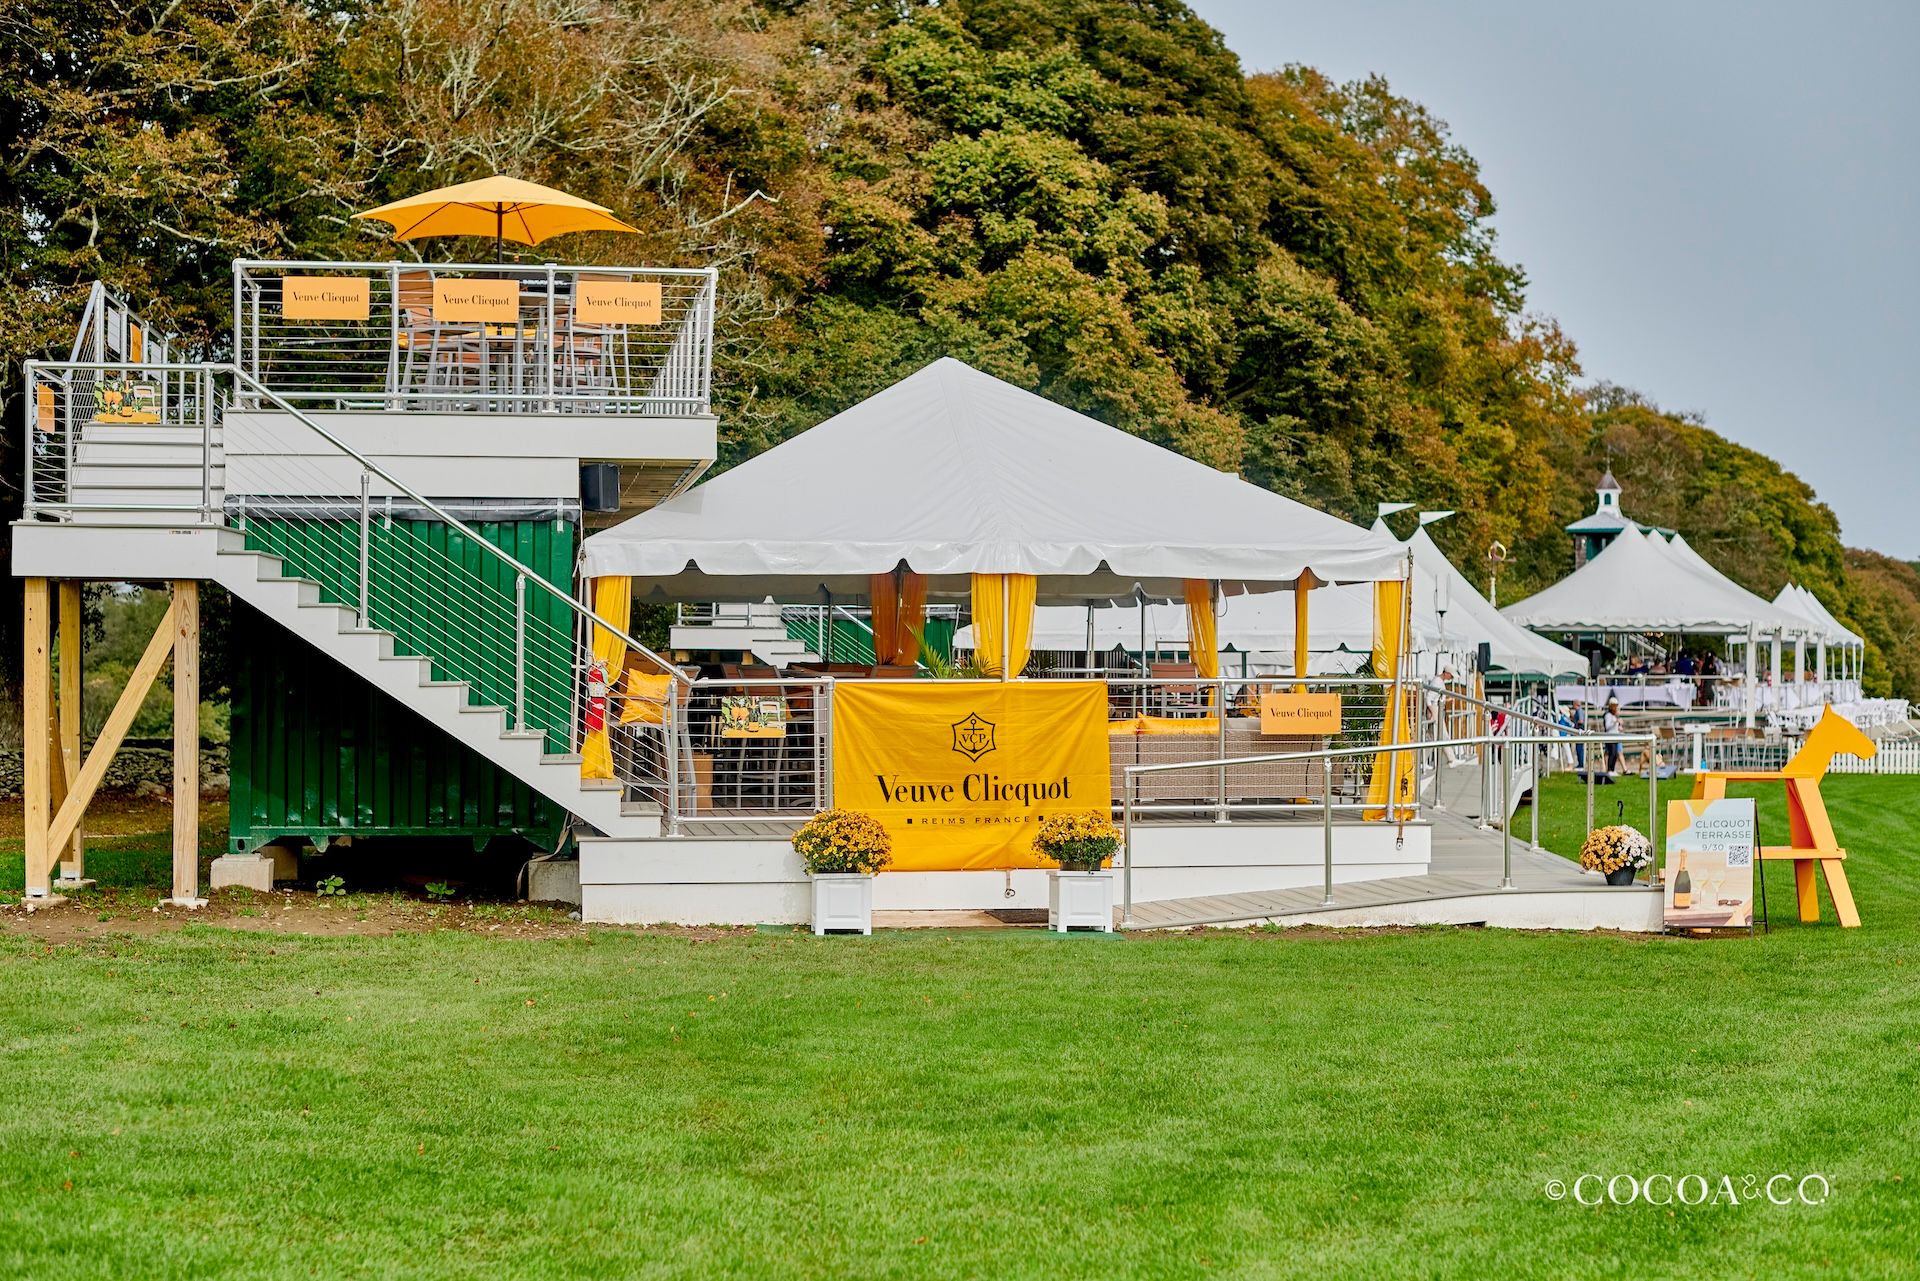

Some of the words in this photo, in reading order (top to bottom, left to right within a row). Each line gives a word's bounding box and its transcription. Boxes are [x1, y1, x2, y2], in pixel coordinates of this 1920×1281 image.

[293, 291, 319, 301] Veuve
[321, 291, 359, 304] Clicquot
[443, 294, 469, 304] Veuve
[471, 294, 510, 307] Clicquot
[586, 296, 612, 306] Veuve
[614, 297, 652, 309] Clicquot
[1270, 707, 1295, 718] Veuve
[1297, 707, 1333, 719] Clicquot
[961, 733, 986, 744] VCP
[874, 775, 954, 803] Veuve
[962, 774, 1072, 807] Clicquot
[975, 815, 1031, 825] FRANCE
[1695, 819, 1752, 829] CLICQUOT
[1695, 830, 1752, 840] TERRASSE
[1701, 843, 1725, 852] 9/30
